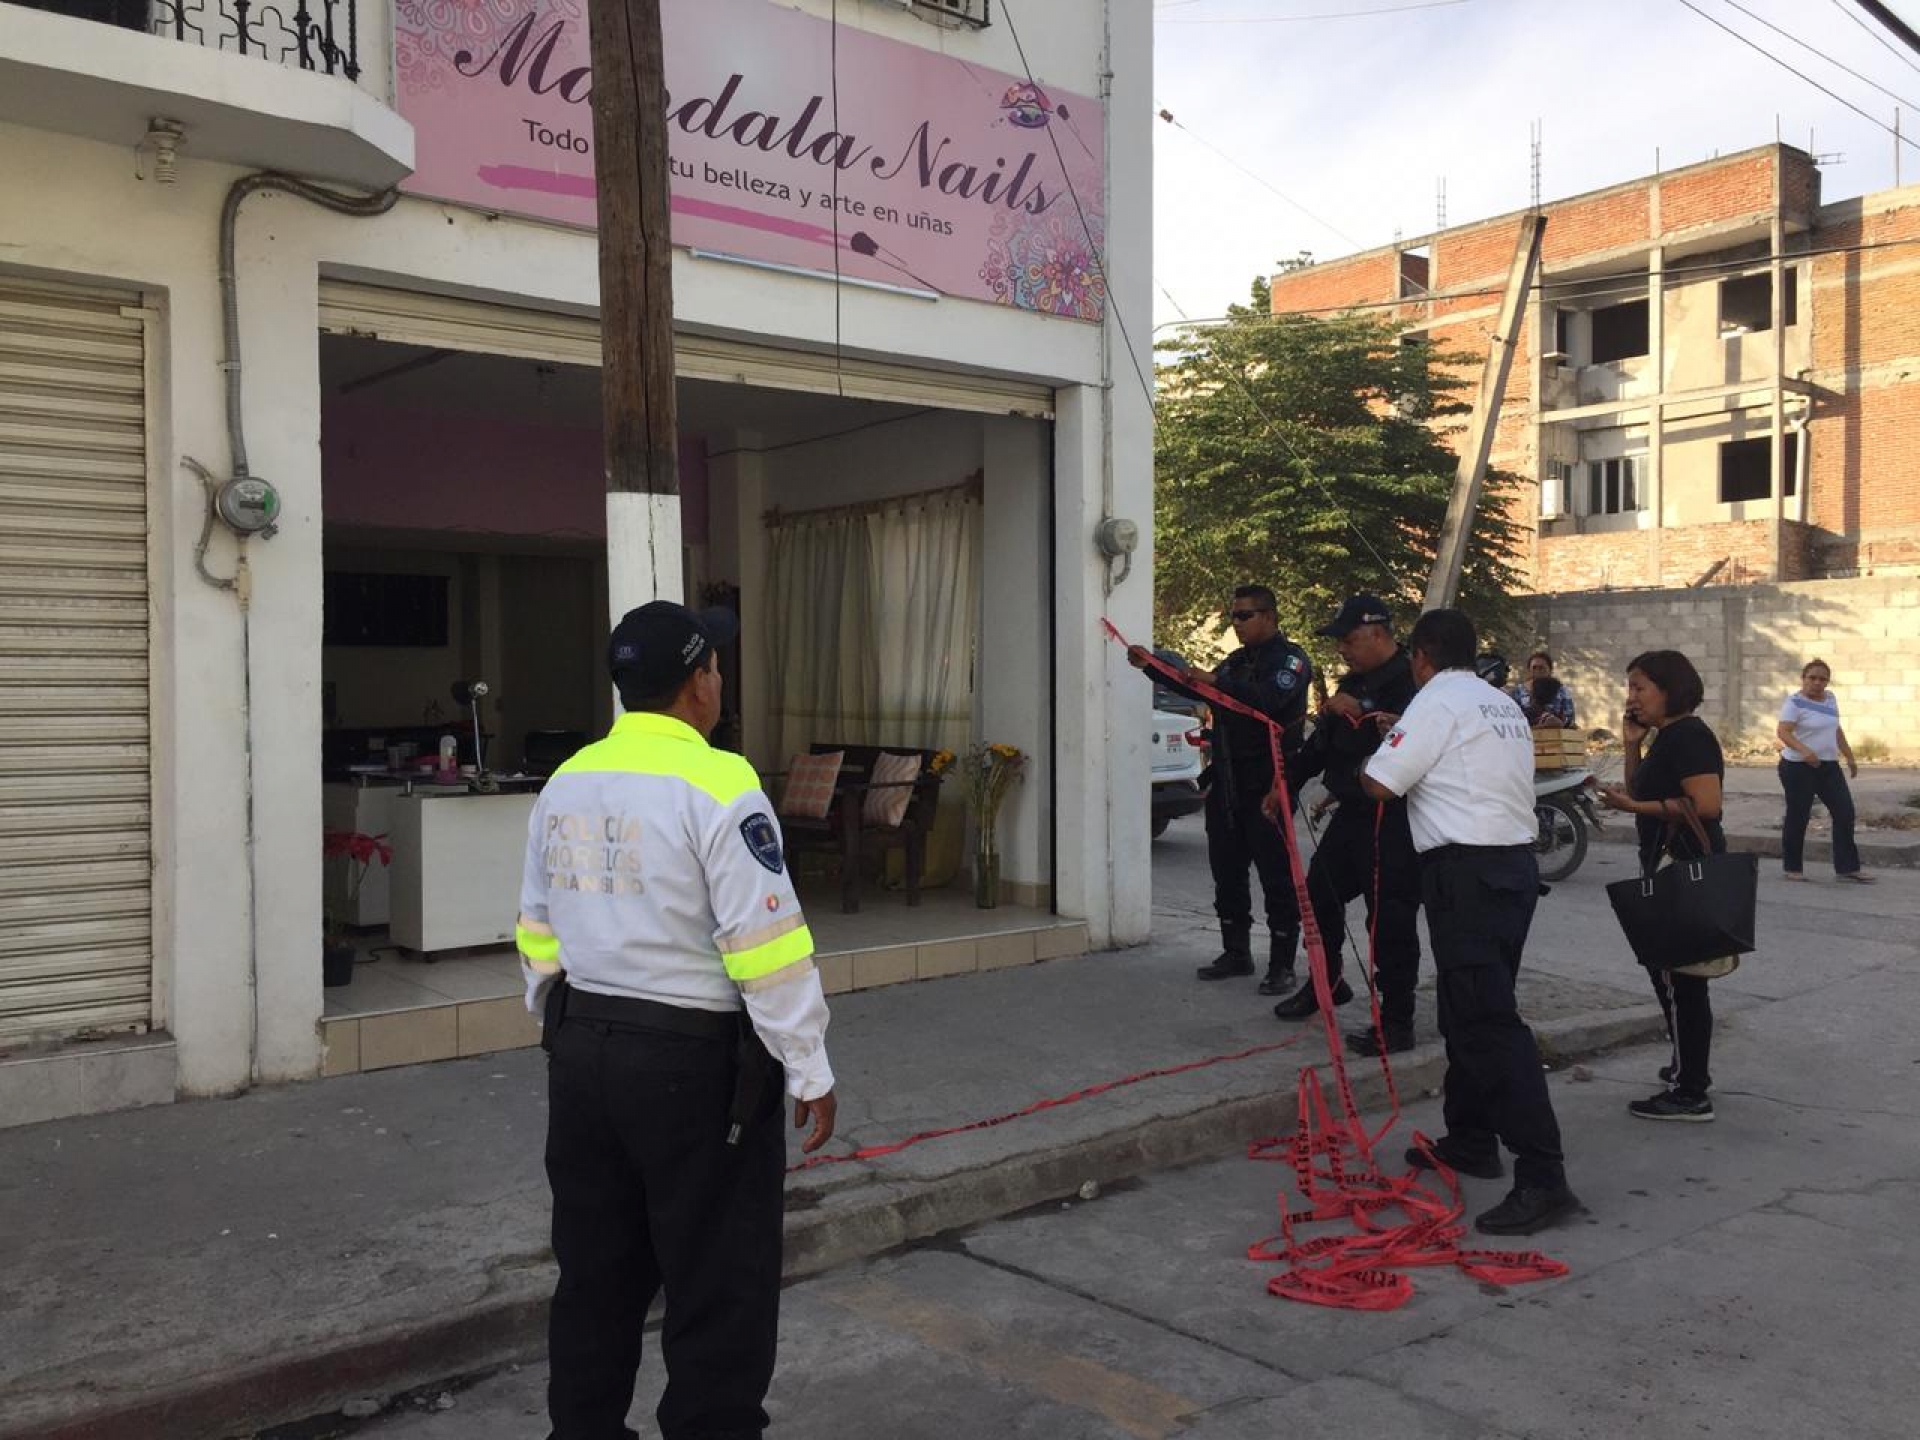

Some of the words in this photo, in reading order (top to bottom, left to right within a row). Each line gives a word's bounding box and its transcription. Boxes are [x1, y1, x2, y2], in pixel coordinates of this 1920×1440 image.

[454, 11, 873, 169] Madala
[871, 120, 1063, 214] Nails
[522, 118, 589, 154] Todo
[669, 156, 694, 178] tu
[704, 162, 791, 201] belleza
[799, 188, 812, 207] y
[820, 193, 865, 216] arte
[873, 205, 898, 224] en
[907, 211, 953, 235] uñas
[544, 845, 642, 874] MORLOS
